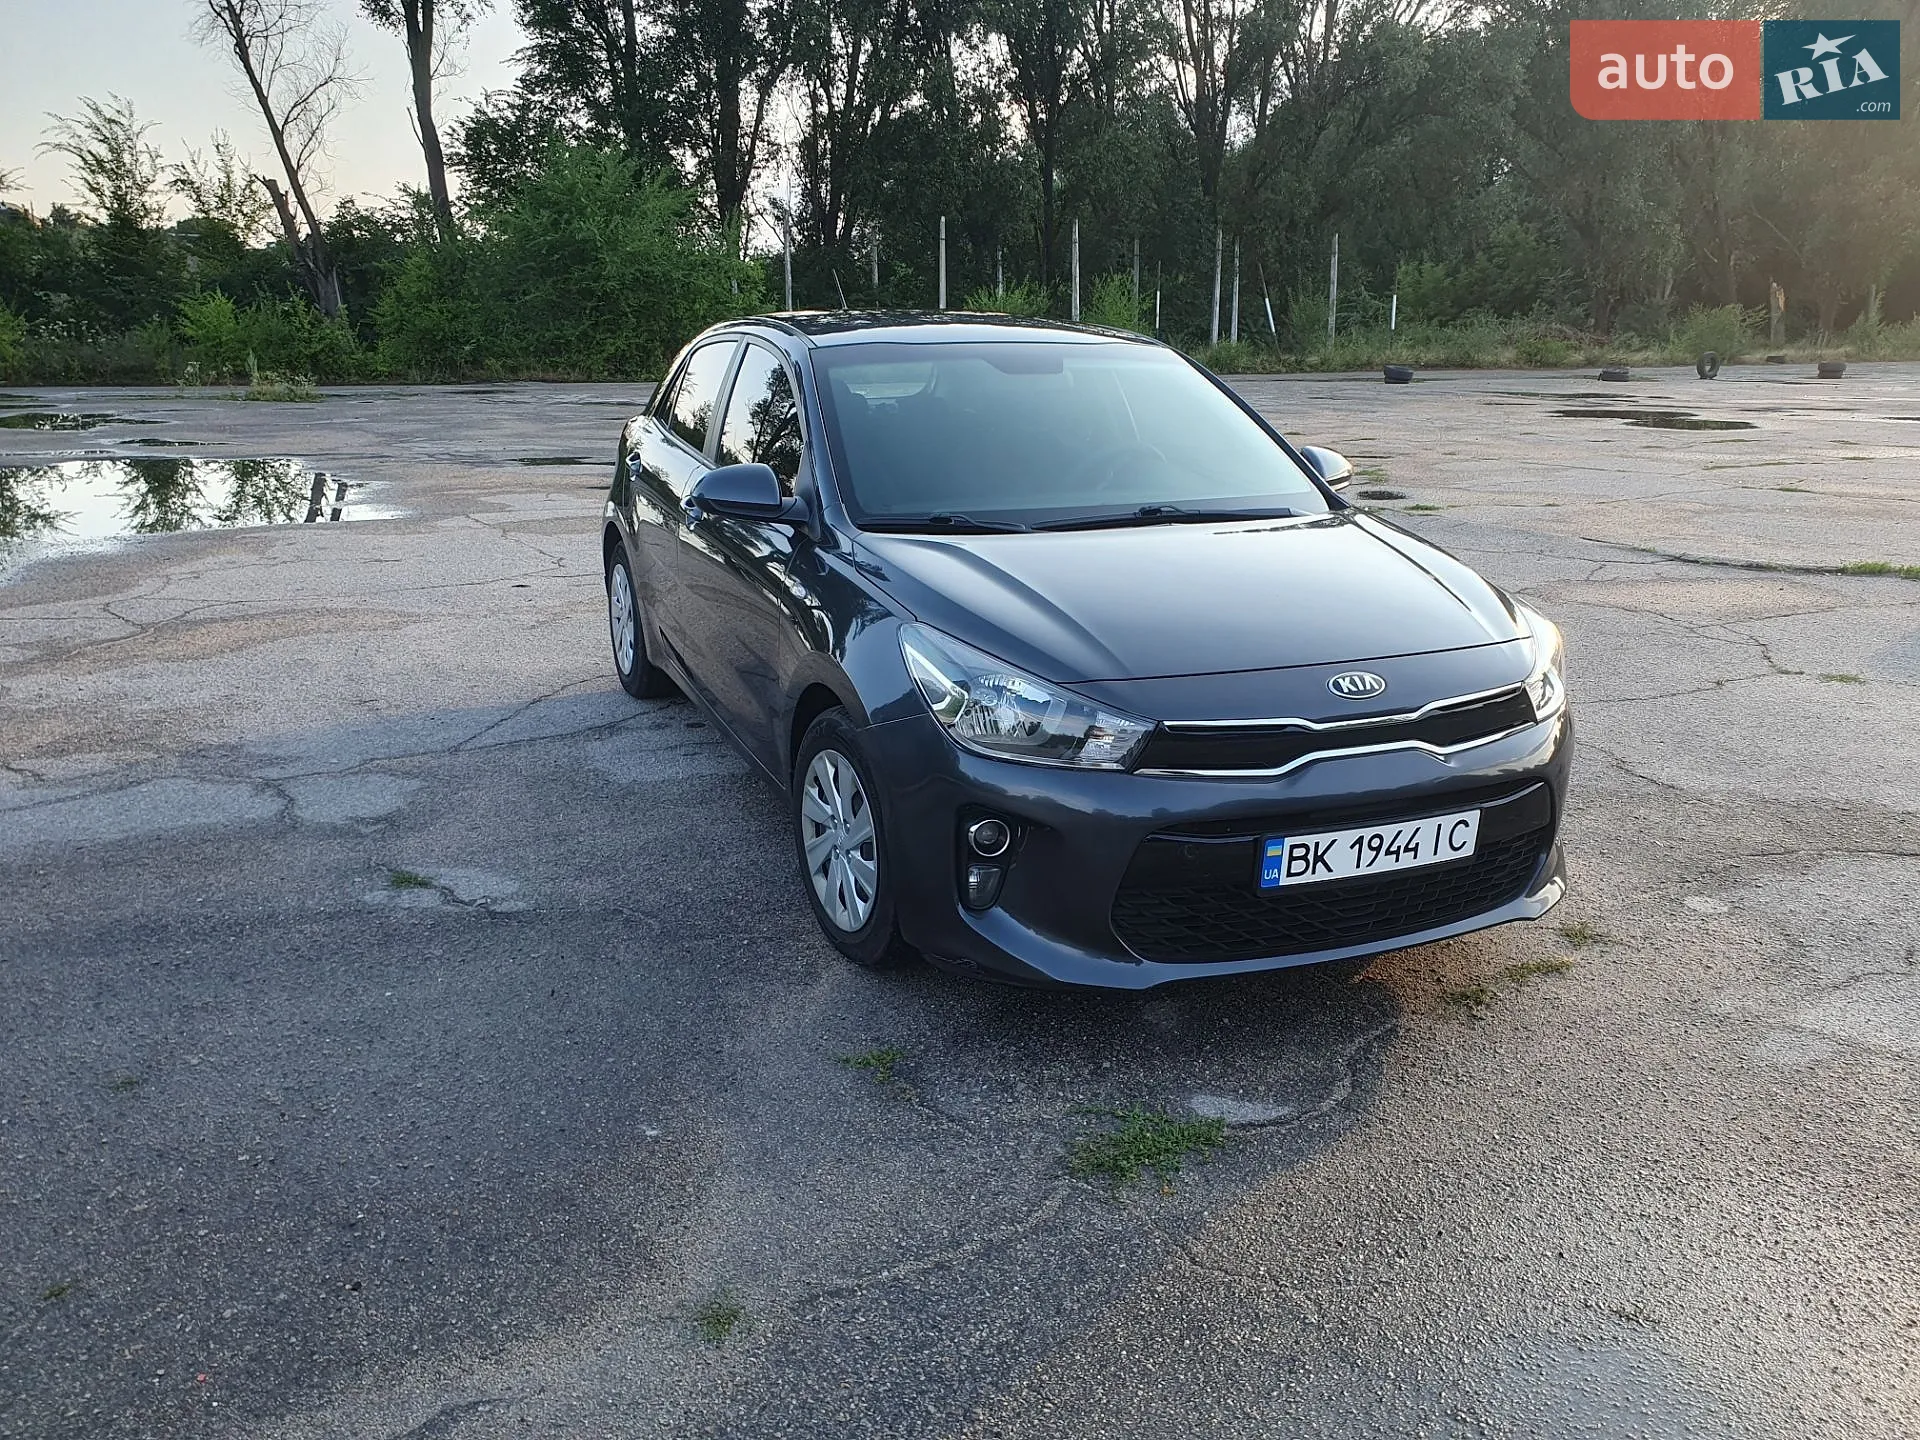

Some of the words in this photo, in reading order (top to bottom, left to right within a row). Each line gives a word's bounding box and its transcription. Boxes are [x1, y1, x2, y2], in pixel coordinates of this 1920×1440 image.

[1336, 675, 1380, 693] KIA
[1286, 838, 1338, 878] BK
[1350, 827, 1421, 868] 1944
[1433, 819, 1470, 856] IC
[1264, 868, 1279, 880] UA
